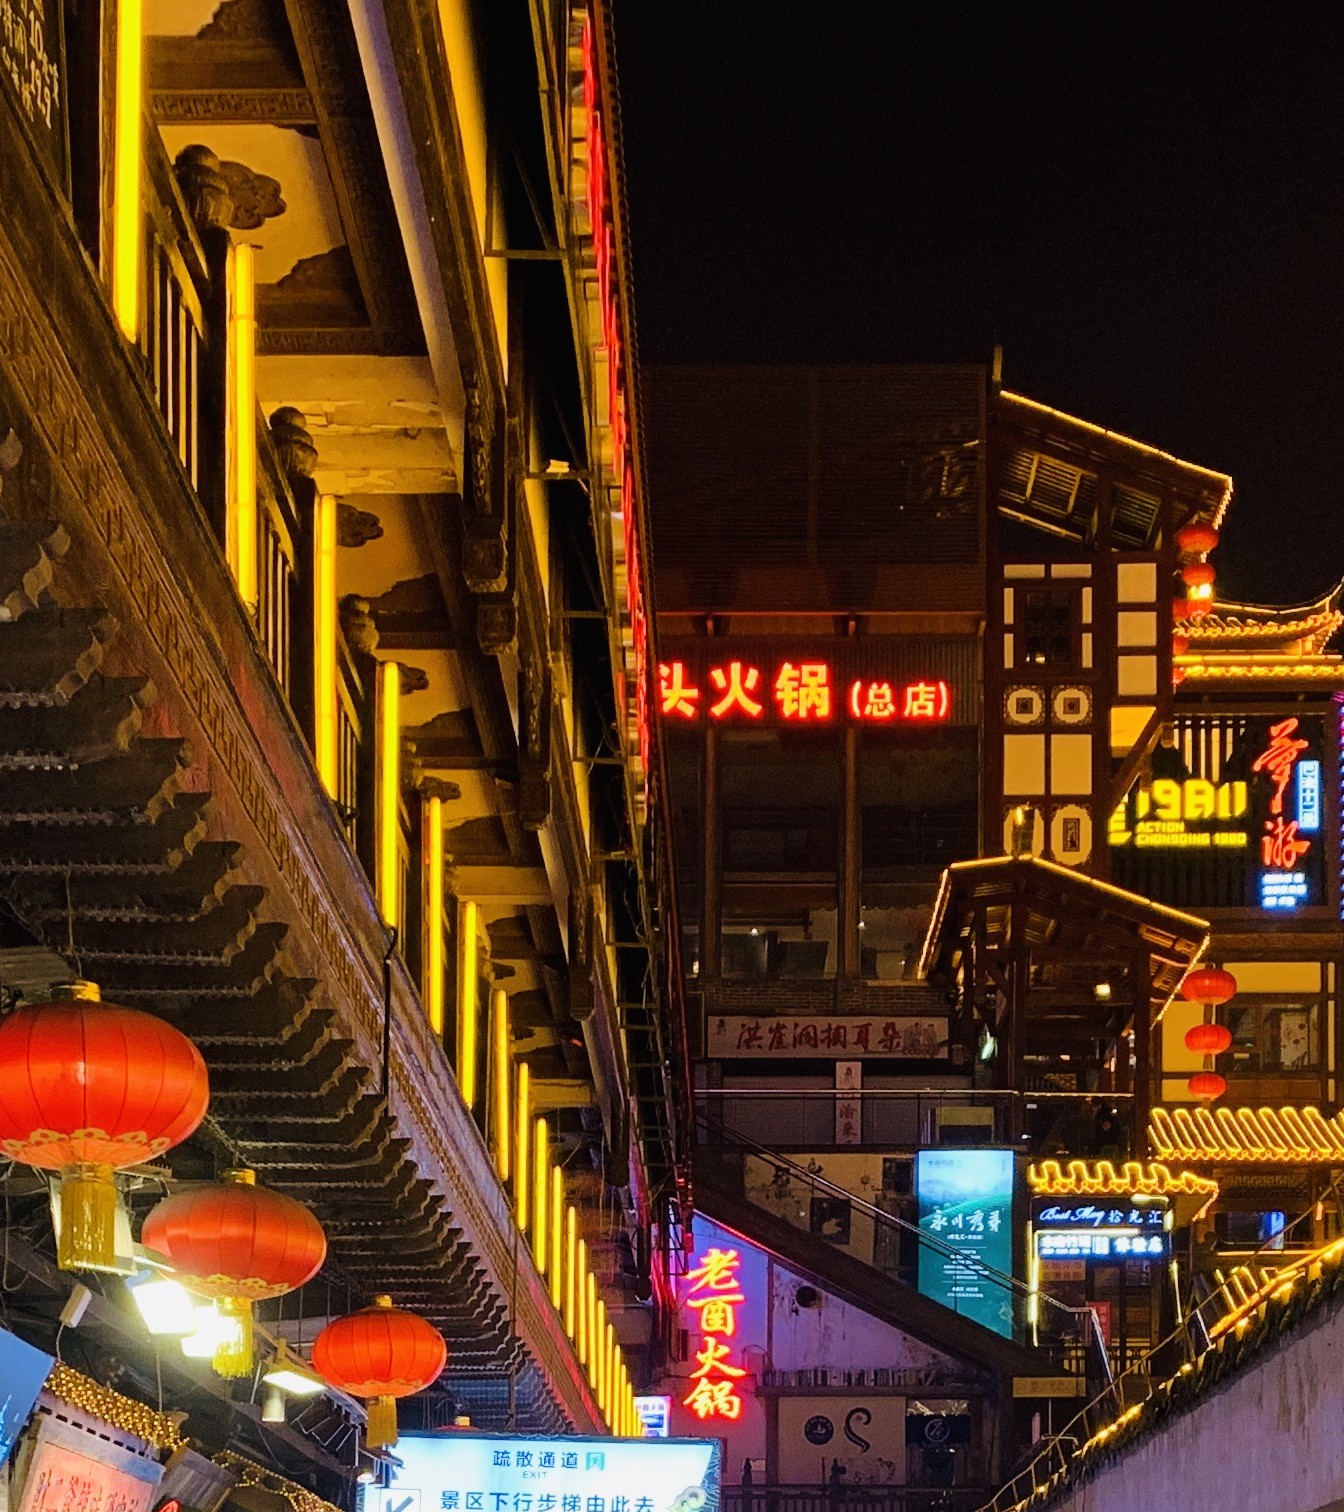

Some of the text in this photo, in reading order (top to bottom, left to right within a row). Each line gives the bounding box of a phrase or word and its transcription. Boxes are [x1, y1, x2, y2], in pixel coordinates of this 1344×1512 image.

[659, 661, 829, 718] 头火锅
[1136, 821, 1185, 833] ACTION
[929, 1209, 1002, 1233] 永川秀芽
[492, 1450, 578, 1469] 疏散通道
[522, 1471, 548, 1479] EXIT
